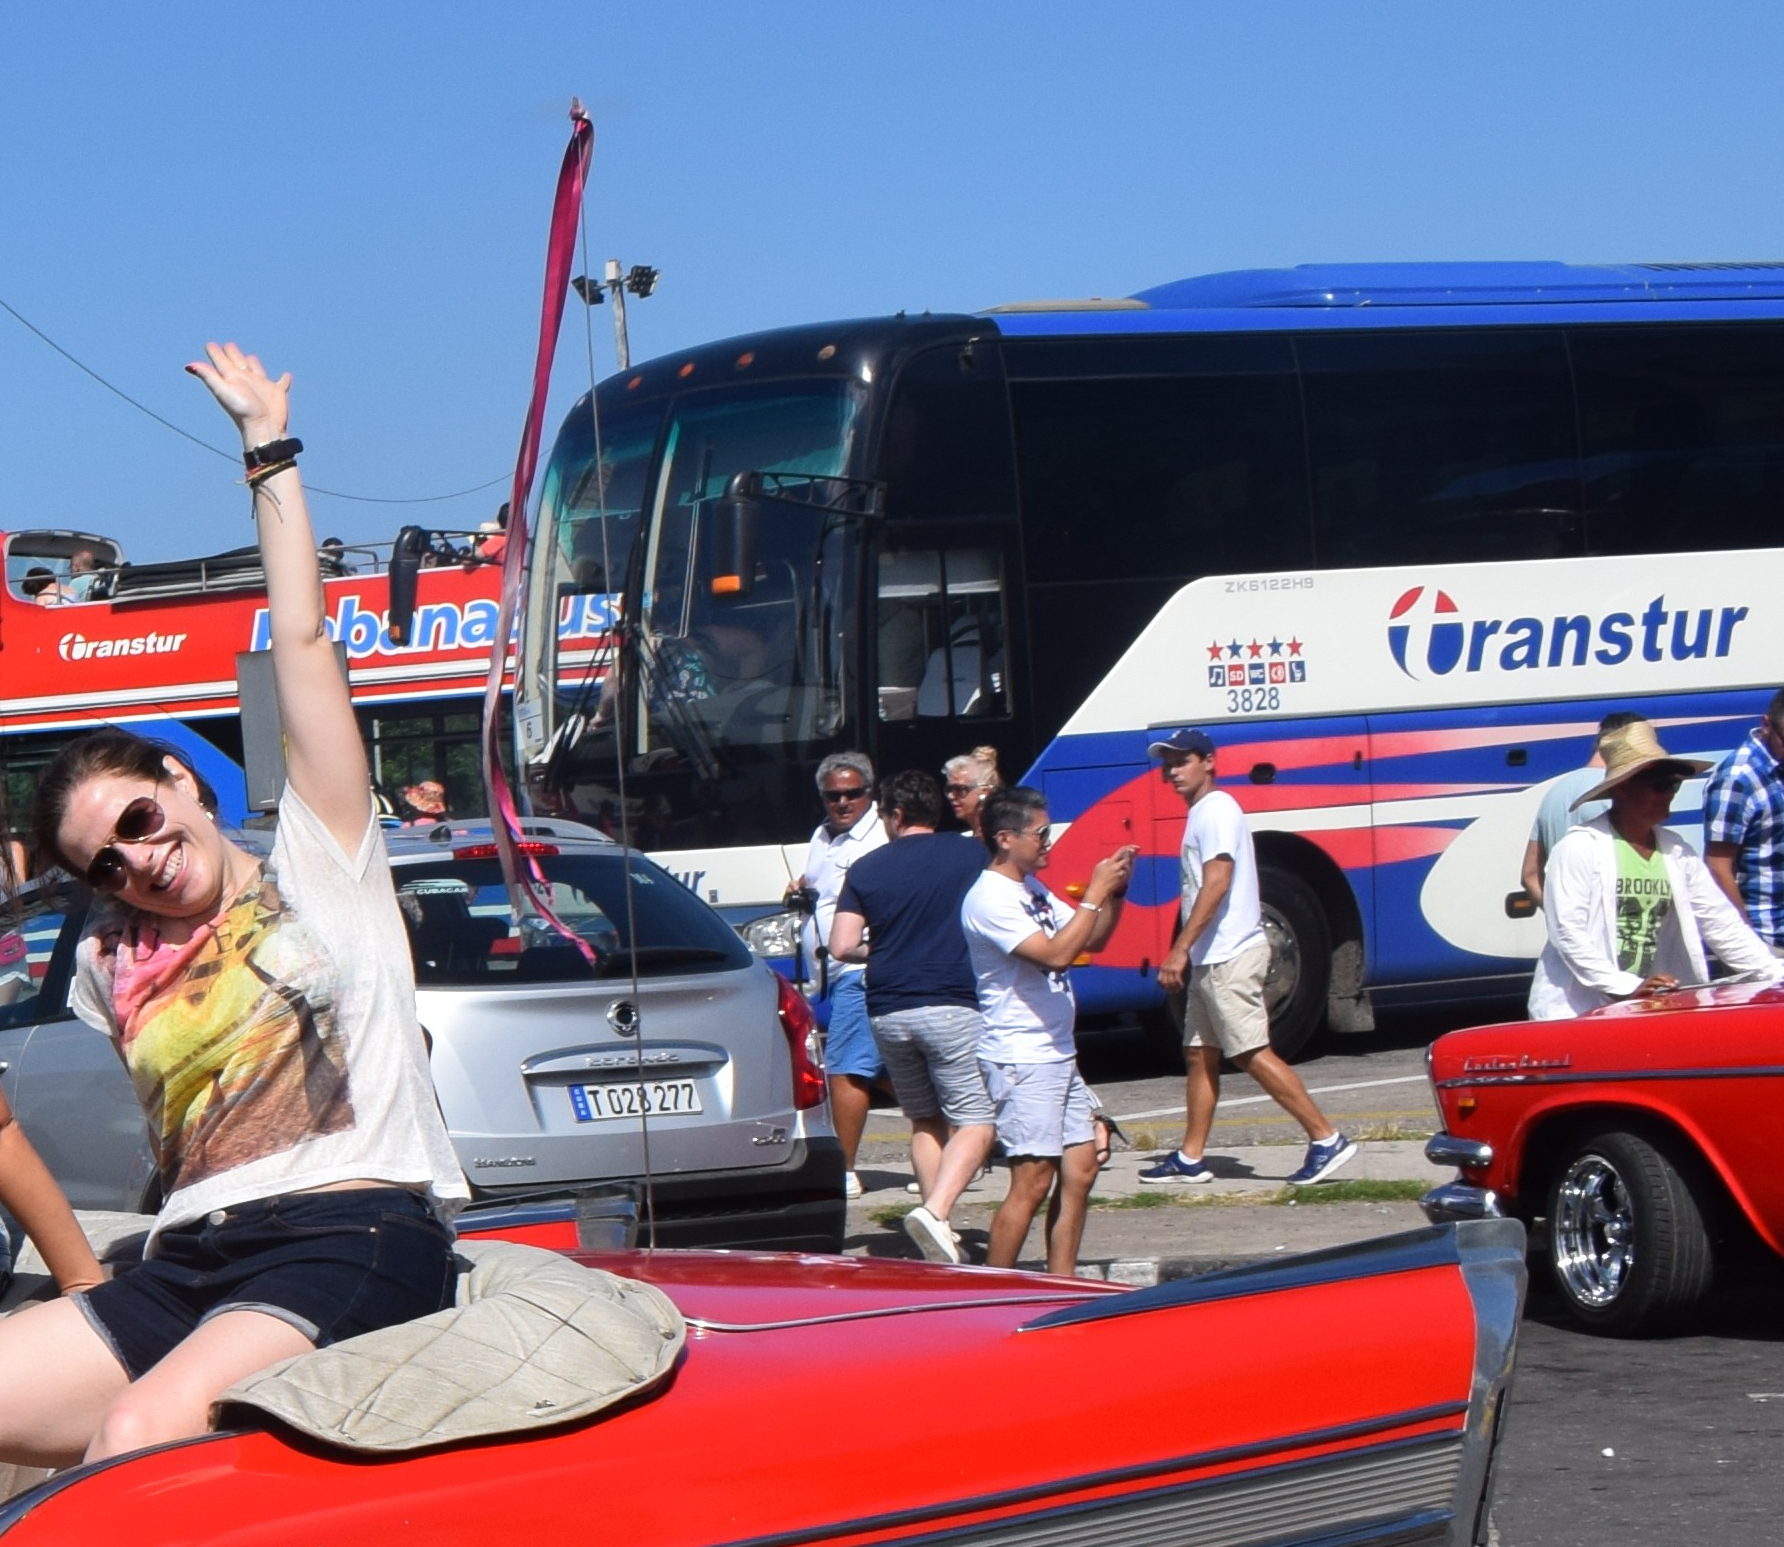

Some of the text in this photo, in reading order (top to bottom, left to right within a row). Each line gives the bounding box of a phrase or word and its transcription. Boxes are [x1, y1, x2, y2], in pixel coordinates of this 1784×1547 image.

[1224, 577, 1315, 593] ZK6122H9
[1227, 686, 1280, 713] 3828
[587, 1083, 694, 1116] T 028 277
